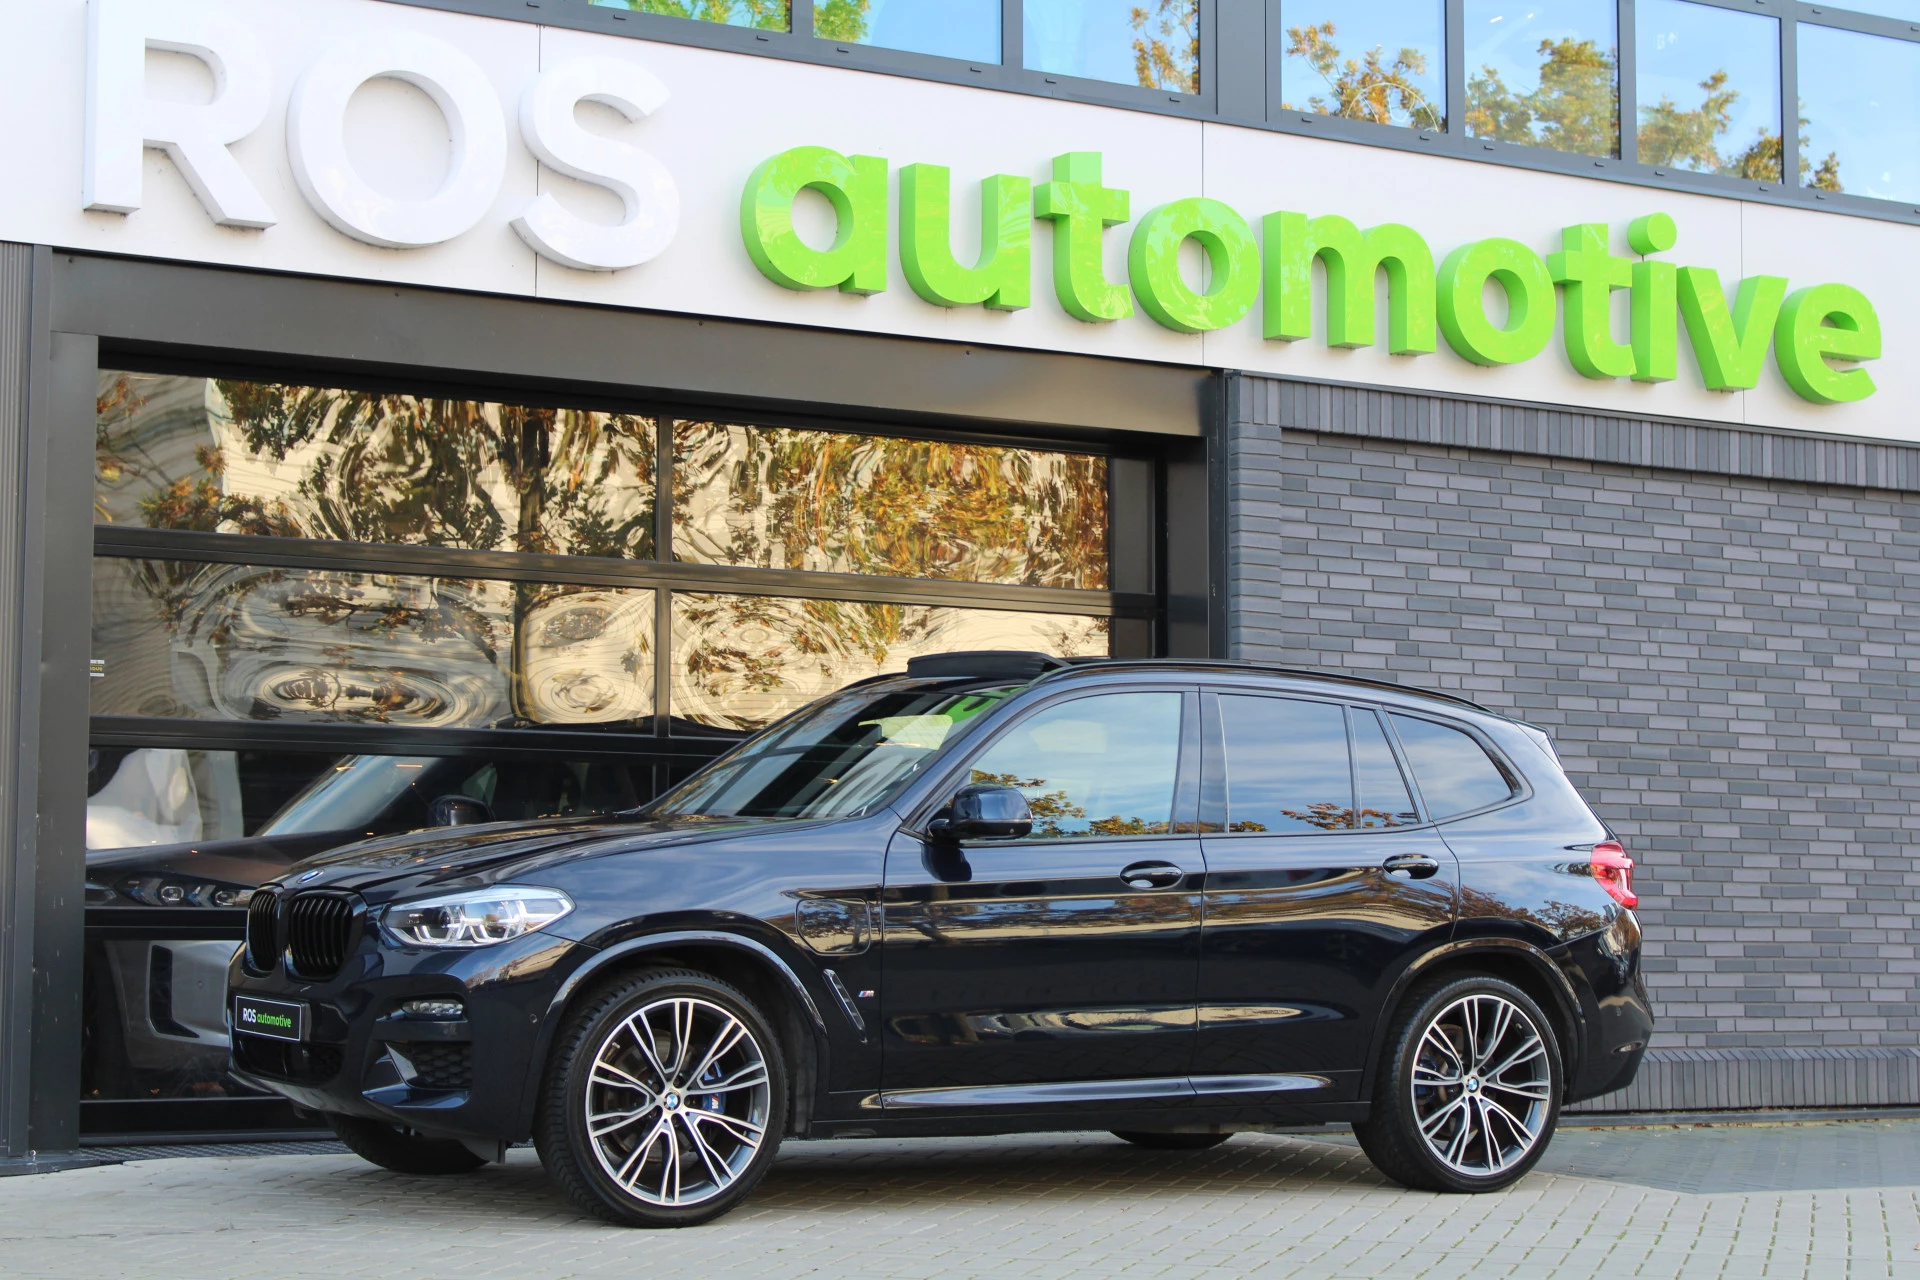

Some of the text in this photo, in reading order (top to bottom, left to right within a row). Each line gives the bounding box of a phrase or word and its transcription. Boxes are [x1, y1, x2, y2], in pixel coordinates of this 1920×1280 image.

[83, 0, 1882, 404] ROS automotive
[242, 1008, 292, 1028] ROS automotive
